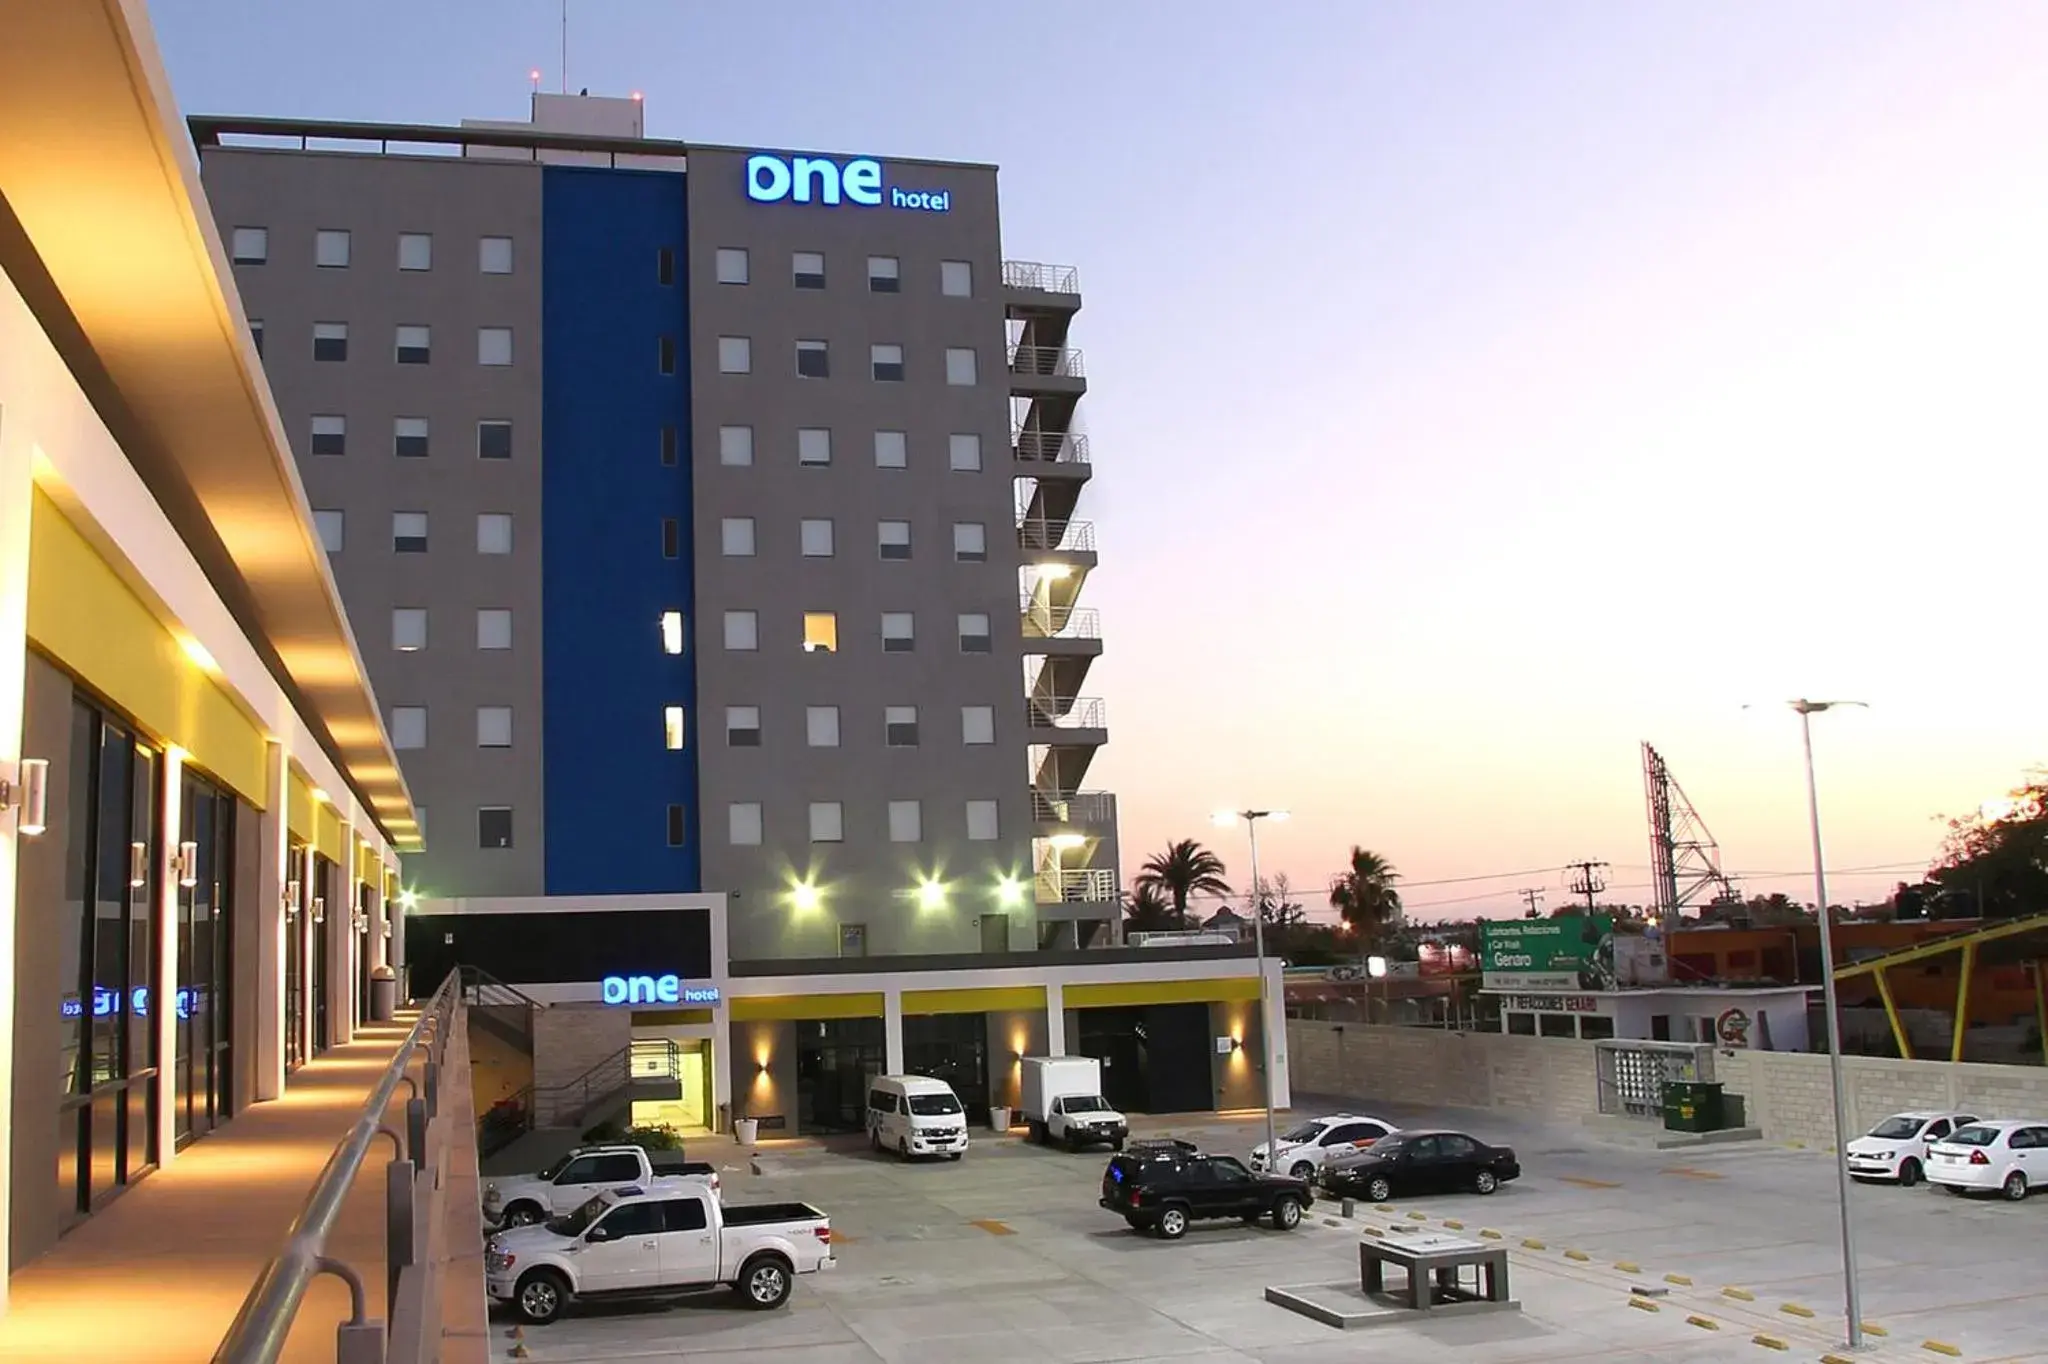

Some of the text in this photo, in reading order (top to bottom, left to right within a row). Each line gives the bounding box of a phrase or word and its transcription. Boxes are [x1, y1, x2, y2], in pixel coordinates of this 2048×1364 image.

[747, 153, 950, 211] one hotel
[1494, 952, 1532, 967] Genaro
[603, 974, 719, 1004] one hotel
